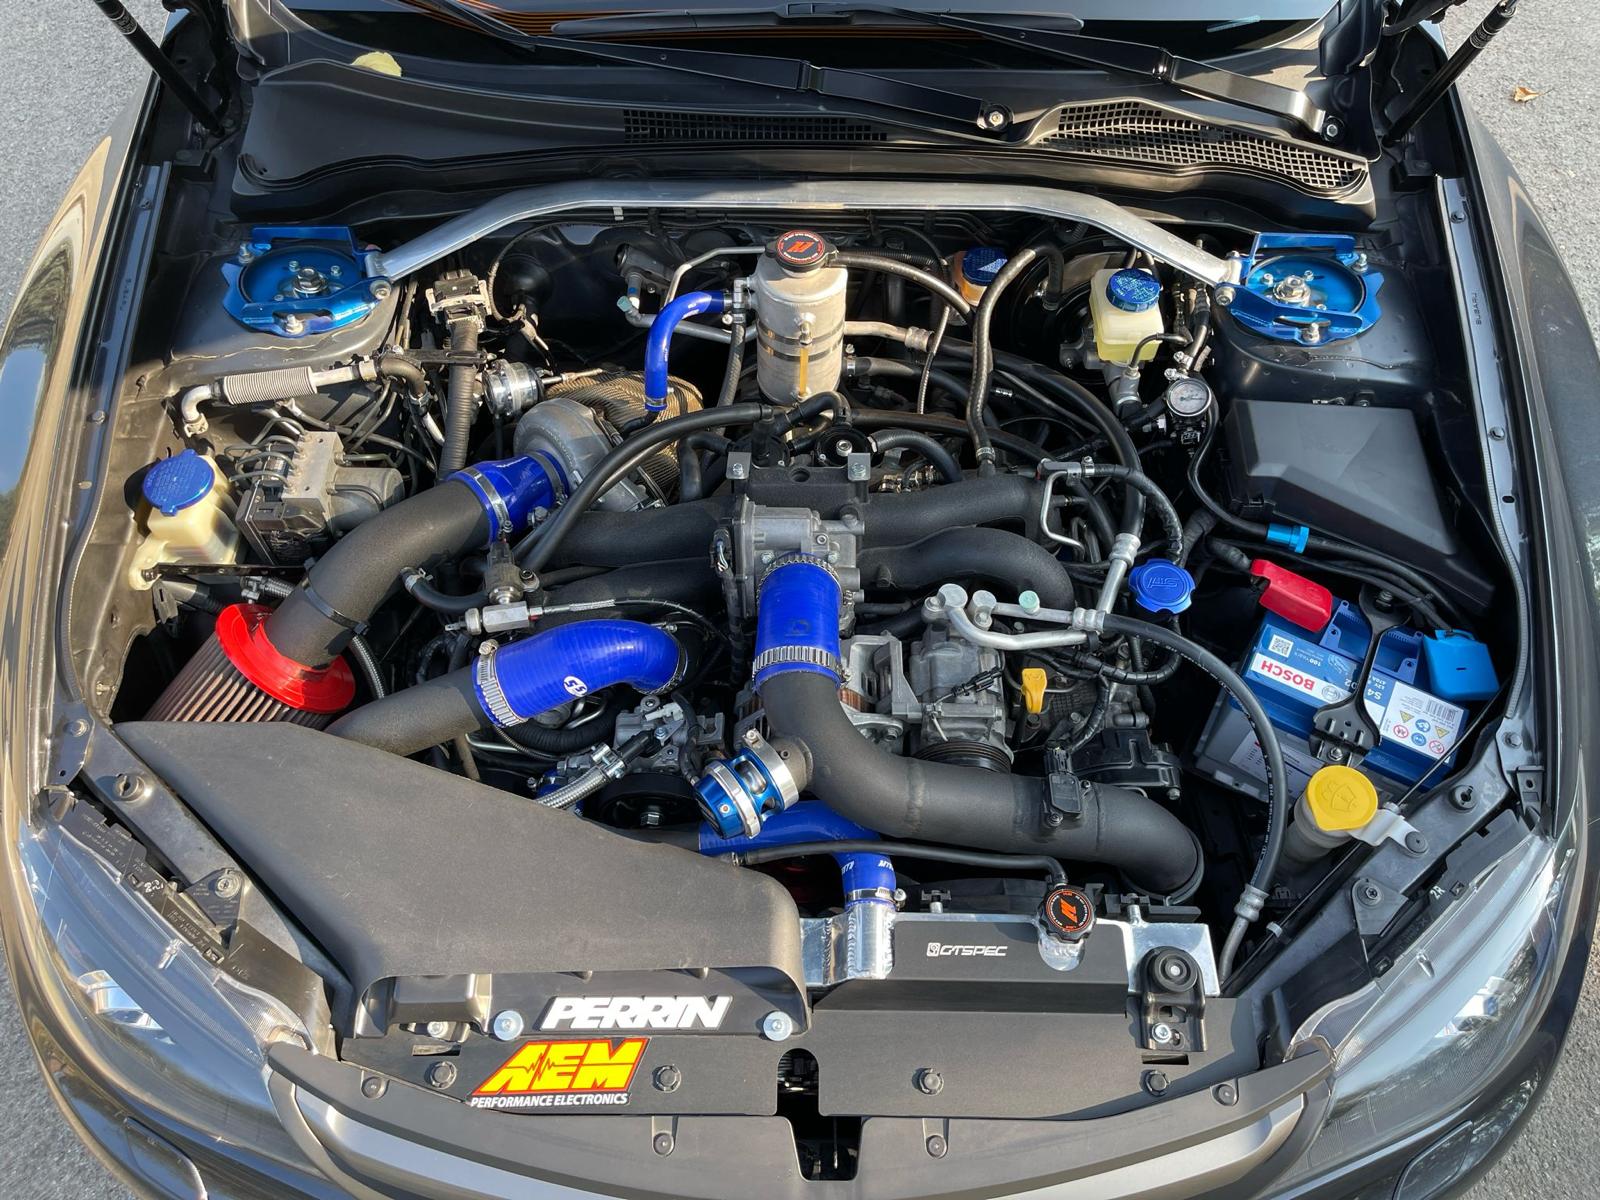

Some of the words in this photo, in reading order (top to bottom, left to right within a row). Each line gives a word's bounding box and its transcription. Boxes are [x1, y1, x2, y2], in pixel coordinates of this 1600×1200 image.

[1260, 660, 1316, 691] BOSCH
[1367, 688, 1382, 700] S4
[940, 945, 1008, 957] GTSPEC
[540, 996, 732, 1030] PERRIN
[474, 1038, 647, 1095] AEM
[470, 1094, 556, 1108] PERFORMANCE
[554, 1092, 629, 1106] ELECTRONICS
